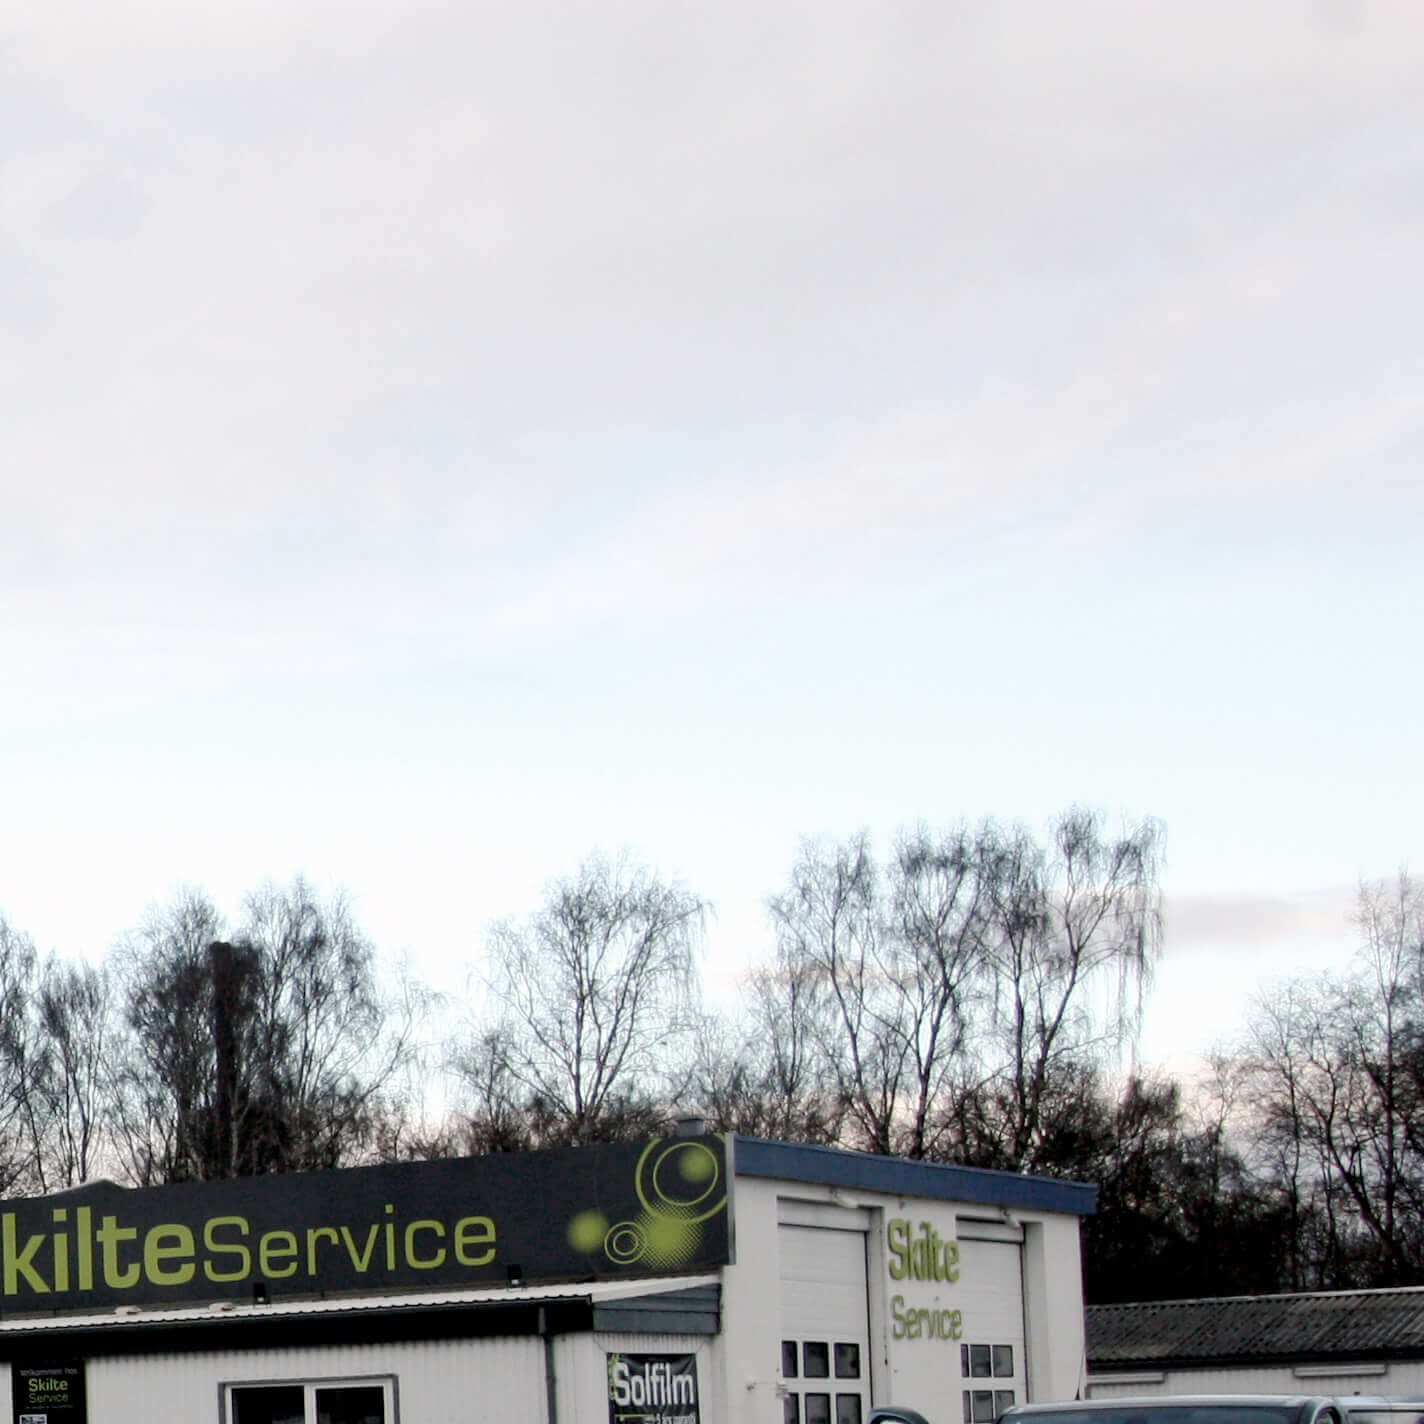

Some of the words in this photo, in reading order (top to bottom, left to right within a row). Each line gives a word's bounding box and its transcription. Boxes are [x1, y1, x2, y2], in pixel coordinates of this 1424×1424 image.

[888, 1219, 960, 1283] Skilte
[891, 1295, 962, 1340] Service
[28, 1378, 68, 1392] Skilte
[28, 1392, 69, 1403] Service
[612, 1361, 695, 1407] Solfilm
